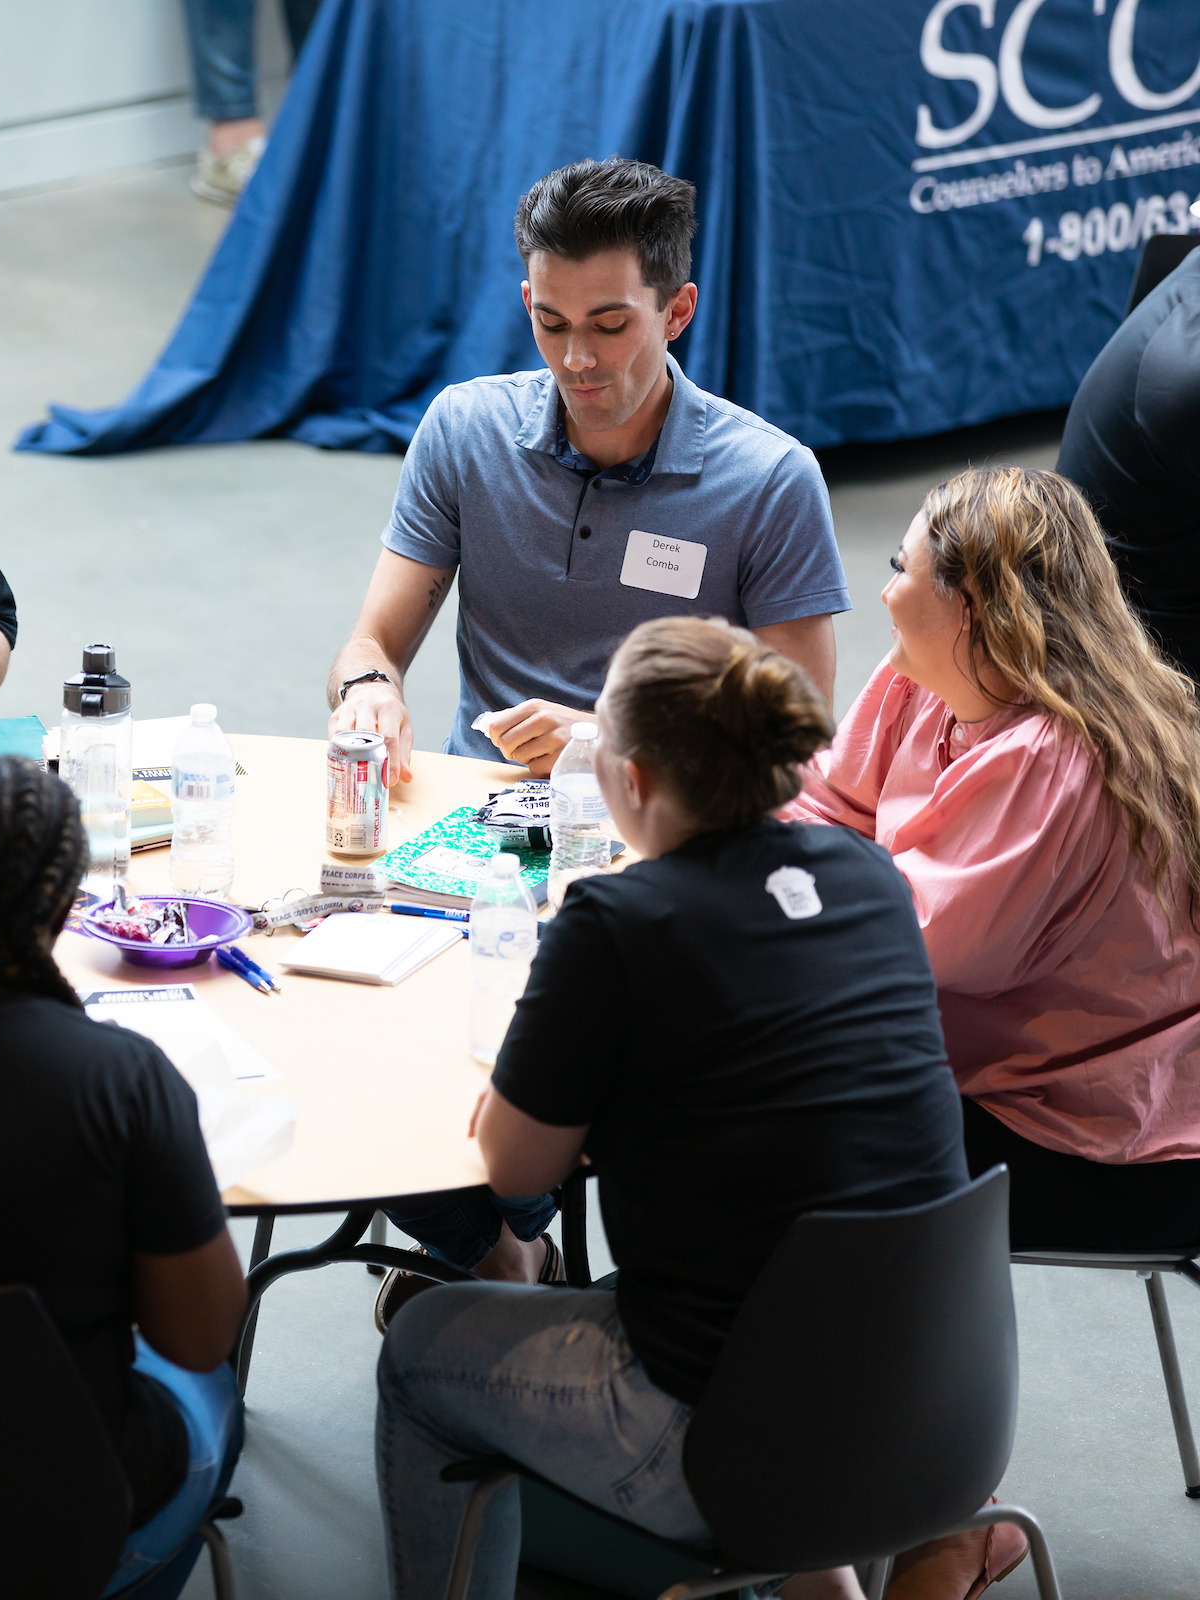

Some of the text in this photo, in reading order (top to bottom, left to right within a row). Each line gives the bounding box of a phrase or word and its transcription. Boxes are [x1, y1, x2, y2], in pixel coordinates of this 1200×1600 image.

[909, 160, 1068, 214] Counselors
[1072, 153, 1102, 187] to
[1022, 190, 1200, 267] 1-800/63
[652, 539, 681, 553] Derek
[646, 556, 680, 572] Comba
[374, 797, 380, 810] ME
[322, 870, 344, 879] PEACE
[344, 872, 366, 880] CORPS
[271, 912, 292, 923] PEACE
[293, 907, 313, 917] CORPS
